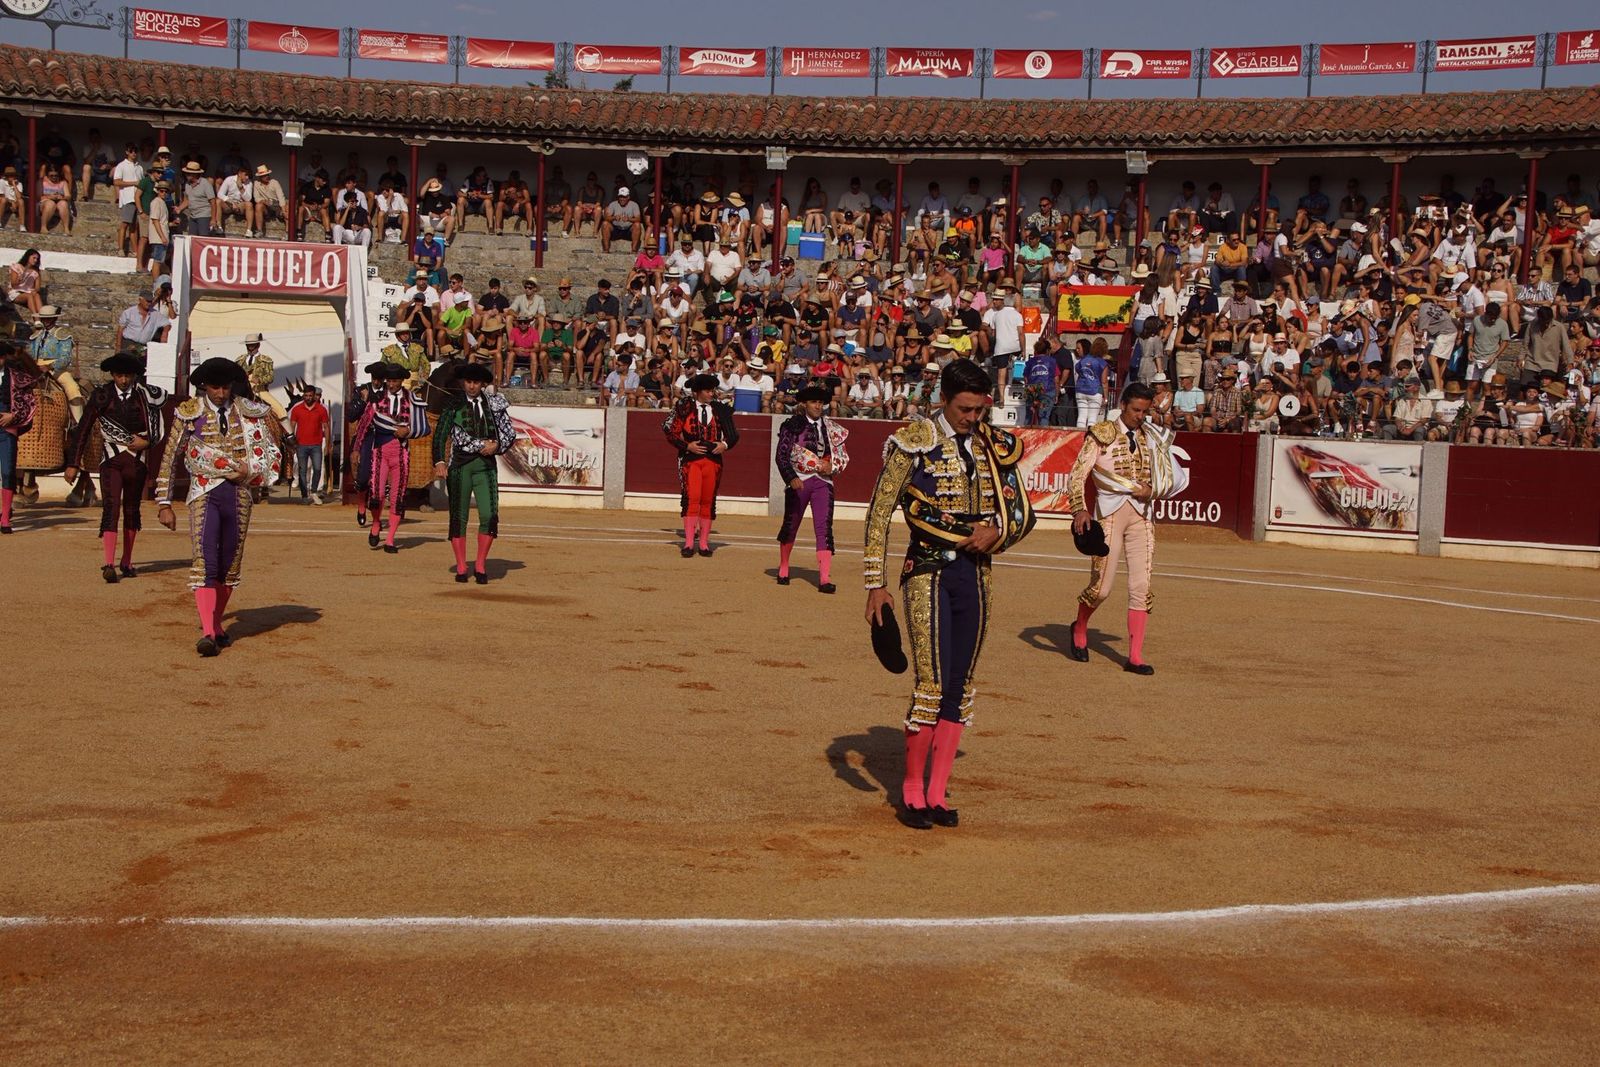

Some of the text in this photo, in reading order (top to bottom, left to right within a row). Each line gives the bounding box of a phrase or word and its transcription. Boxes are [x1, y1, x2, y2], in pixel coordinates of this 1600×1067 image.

[135, 10, 201, 28] MONTAJES
[701, 52, 745, 65] ALJOMAR
[807, 50, 861, 60] HERNÁNDEZ
[807, 59, 844, 68] JIMÉNEZ
[899, 56, 962, 71] MAJUMA
[1236, 55, 1298, 68] GARBLA
[1438, 59, 1490, 67] INSTALACIONES
[1322, 63, 1337, 72] José
[1338, 62, 1367, 71] Antonio
[199, 244, 341, 289] GUIJUELO
[381, 301, 392, 309] F6
[1012, 391, 1023, 400] F2
[1285, 400, 1294, 410] 4
[1007, 412, 1016, 420] F1
[1025, 471, 1070, 493] GUIJU
